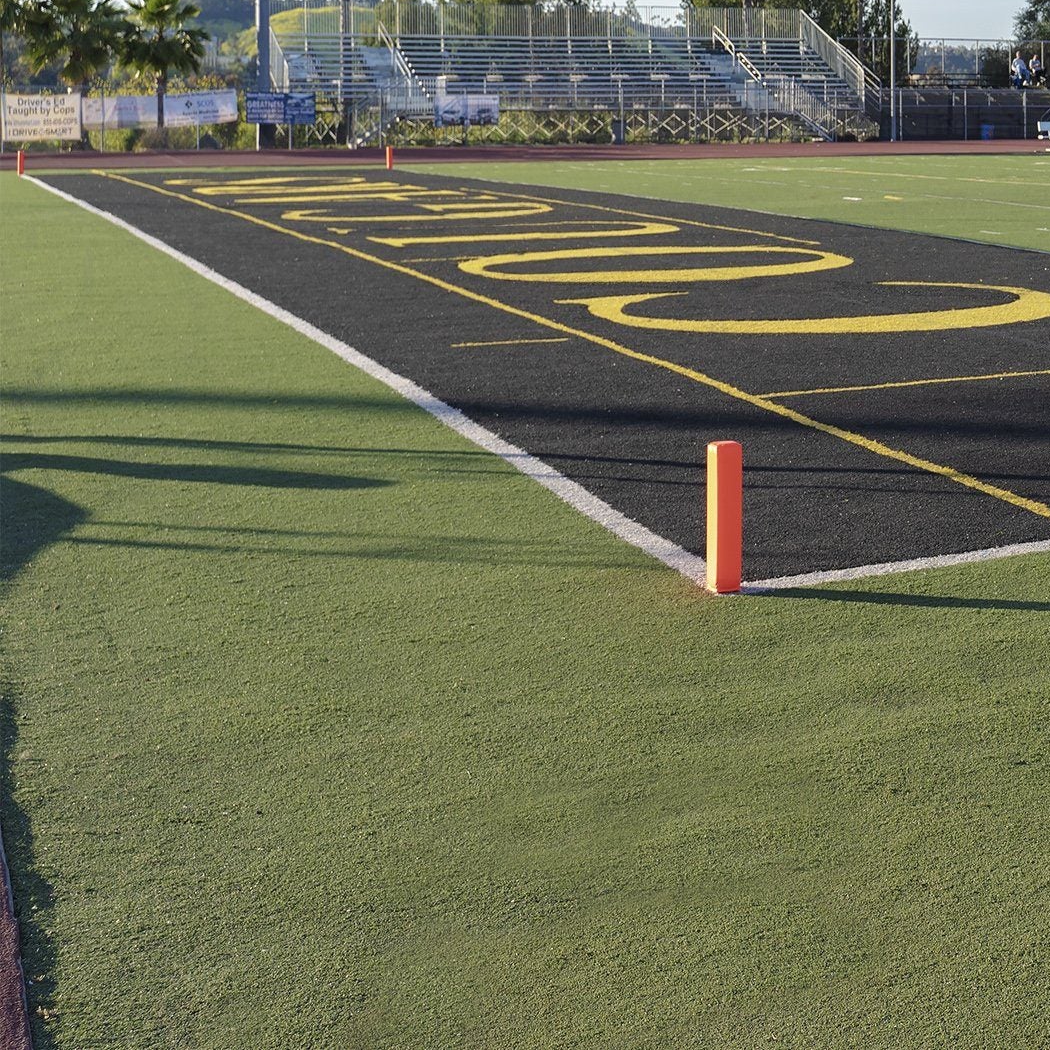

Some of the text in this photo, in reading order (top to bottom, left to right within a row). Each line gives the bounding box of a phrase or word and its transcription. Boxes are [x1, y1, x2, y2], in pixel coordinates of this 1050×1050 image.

[8, 105, 75, 117] Taught by Cops
